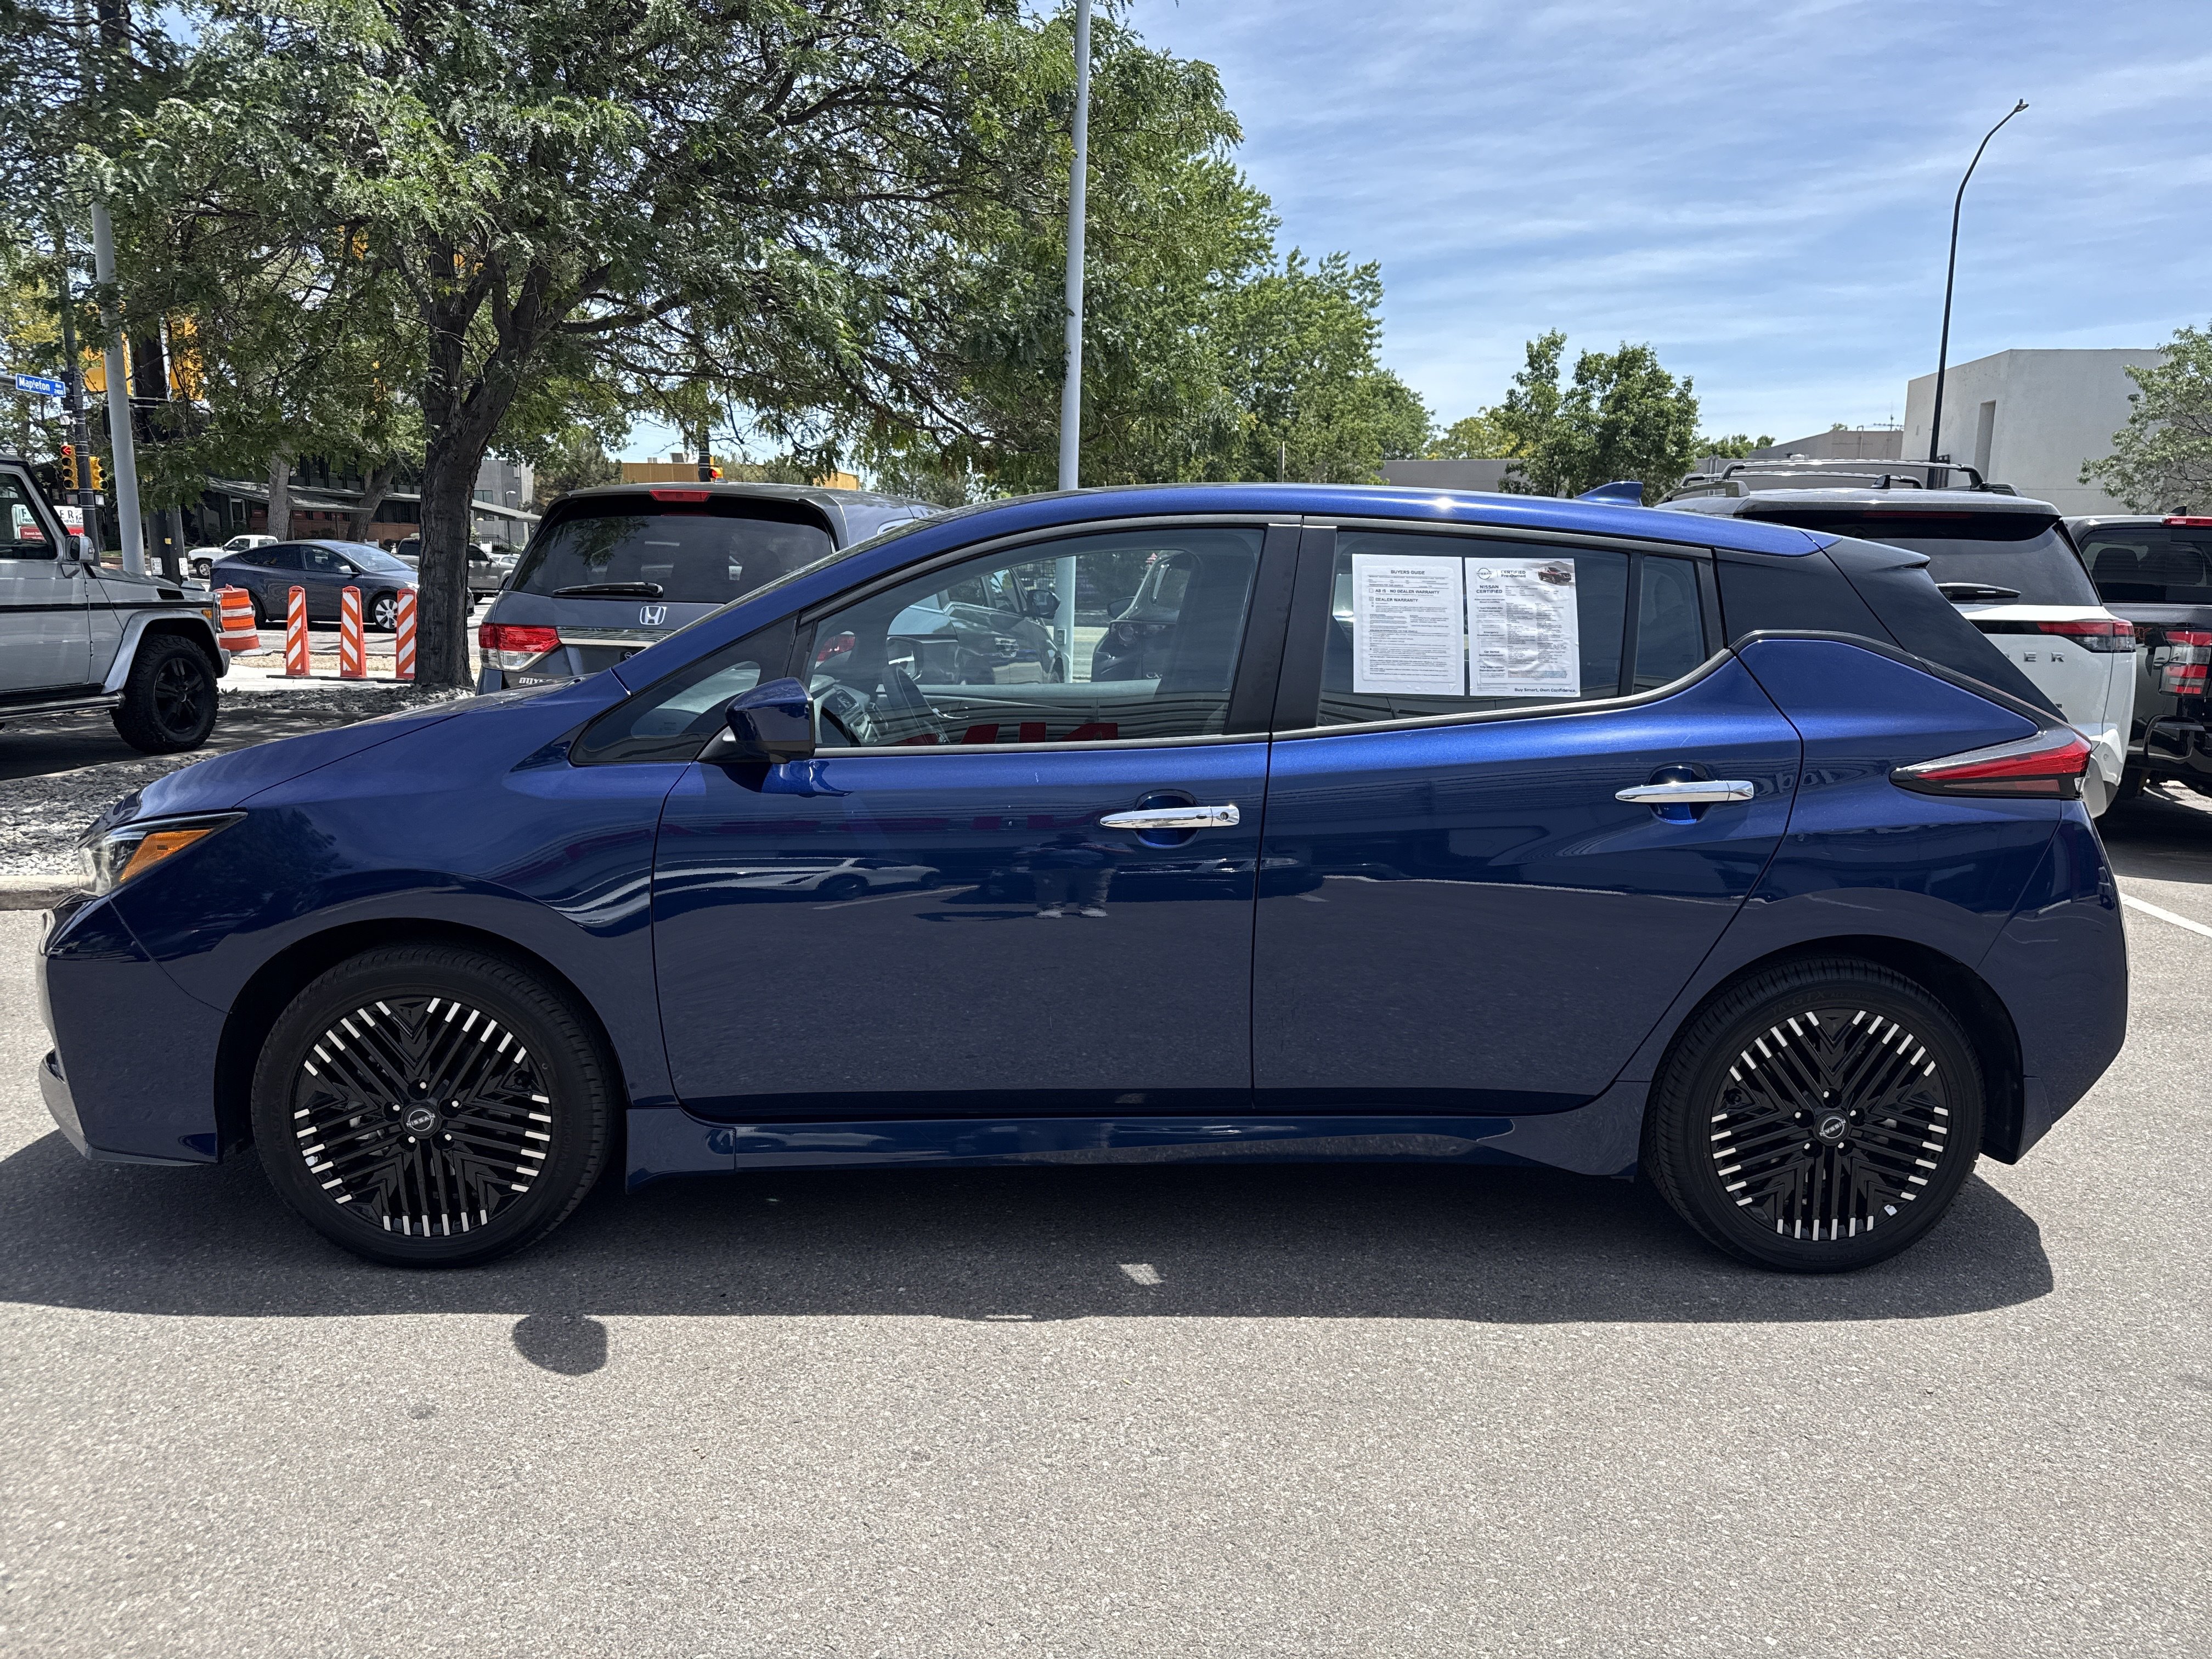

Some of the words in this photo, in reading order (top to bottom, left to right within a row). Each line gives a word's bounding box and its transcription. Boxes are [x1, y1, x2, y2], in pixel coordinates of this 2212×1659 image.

[18, 376, 50, 391] Mapleton
[405, 1113, 436, 1127] NISSAN
[1819, 1119, 1847, 1137] NISSAN
